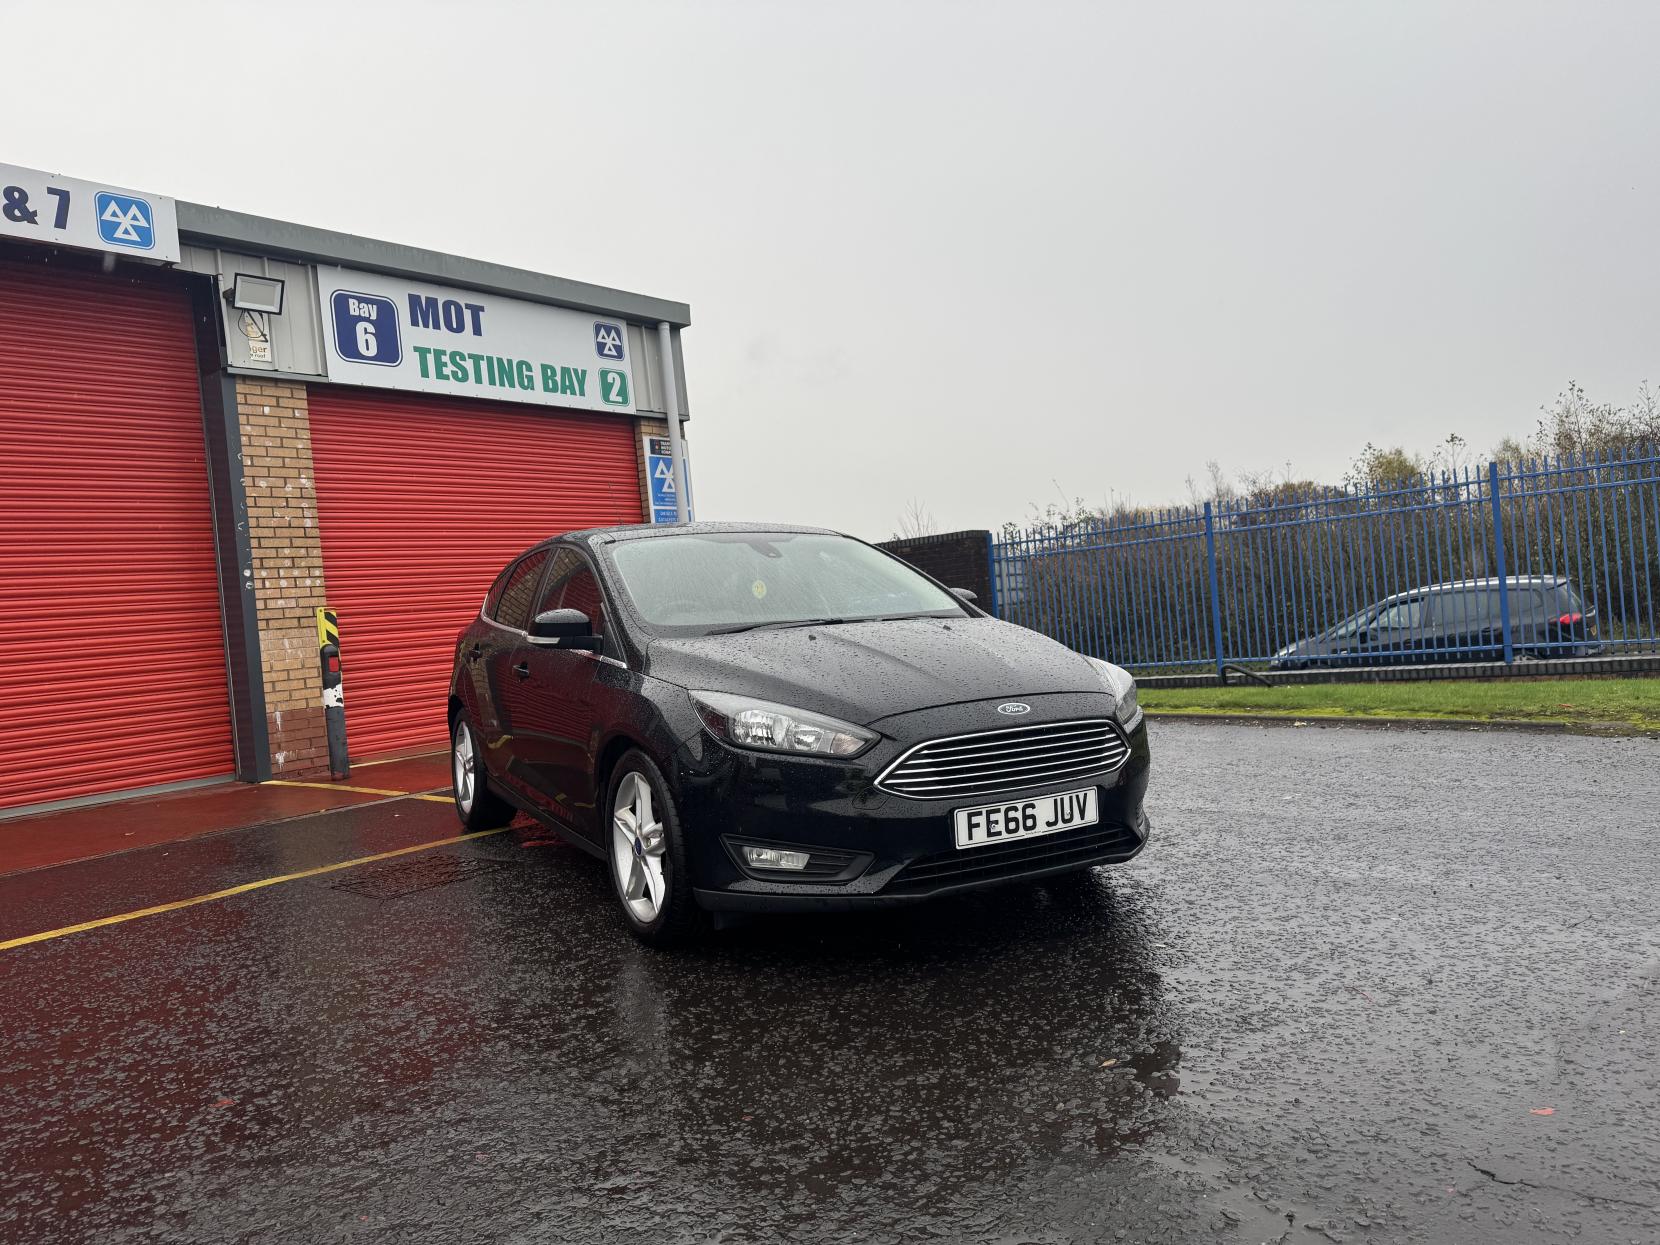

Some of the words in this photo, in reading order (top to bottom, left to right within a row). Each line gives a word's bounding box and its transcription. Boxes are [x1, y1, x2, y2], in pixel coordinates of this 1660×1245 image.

[3, 186, 38, 225] &
[47, 186, 71, 230] 7
[348, 298, 377, 320] Bay
[408, 293, 485, 336] MOT
[356, 322, 378, 357] 6
[413, 346, 534, 391] TESTING
[541, 364, 588, 397] BAY
[608, 372, 623, 402] 2
[1005, 704, 1024, 713] Ford
[967, 803, 1037, 840] FE66
[1046, 793, 1088, 827] JUV
